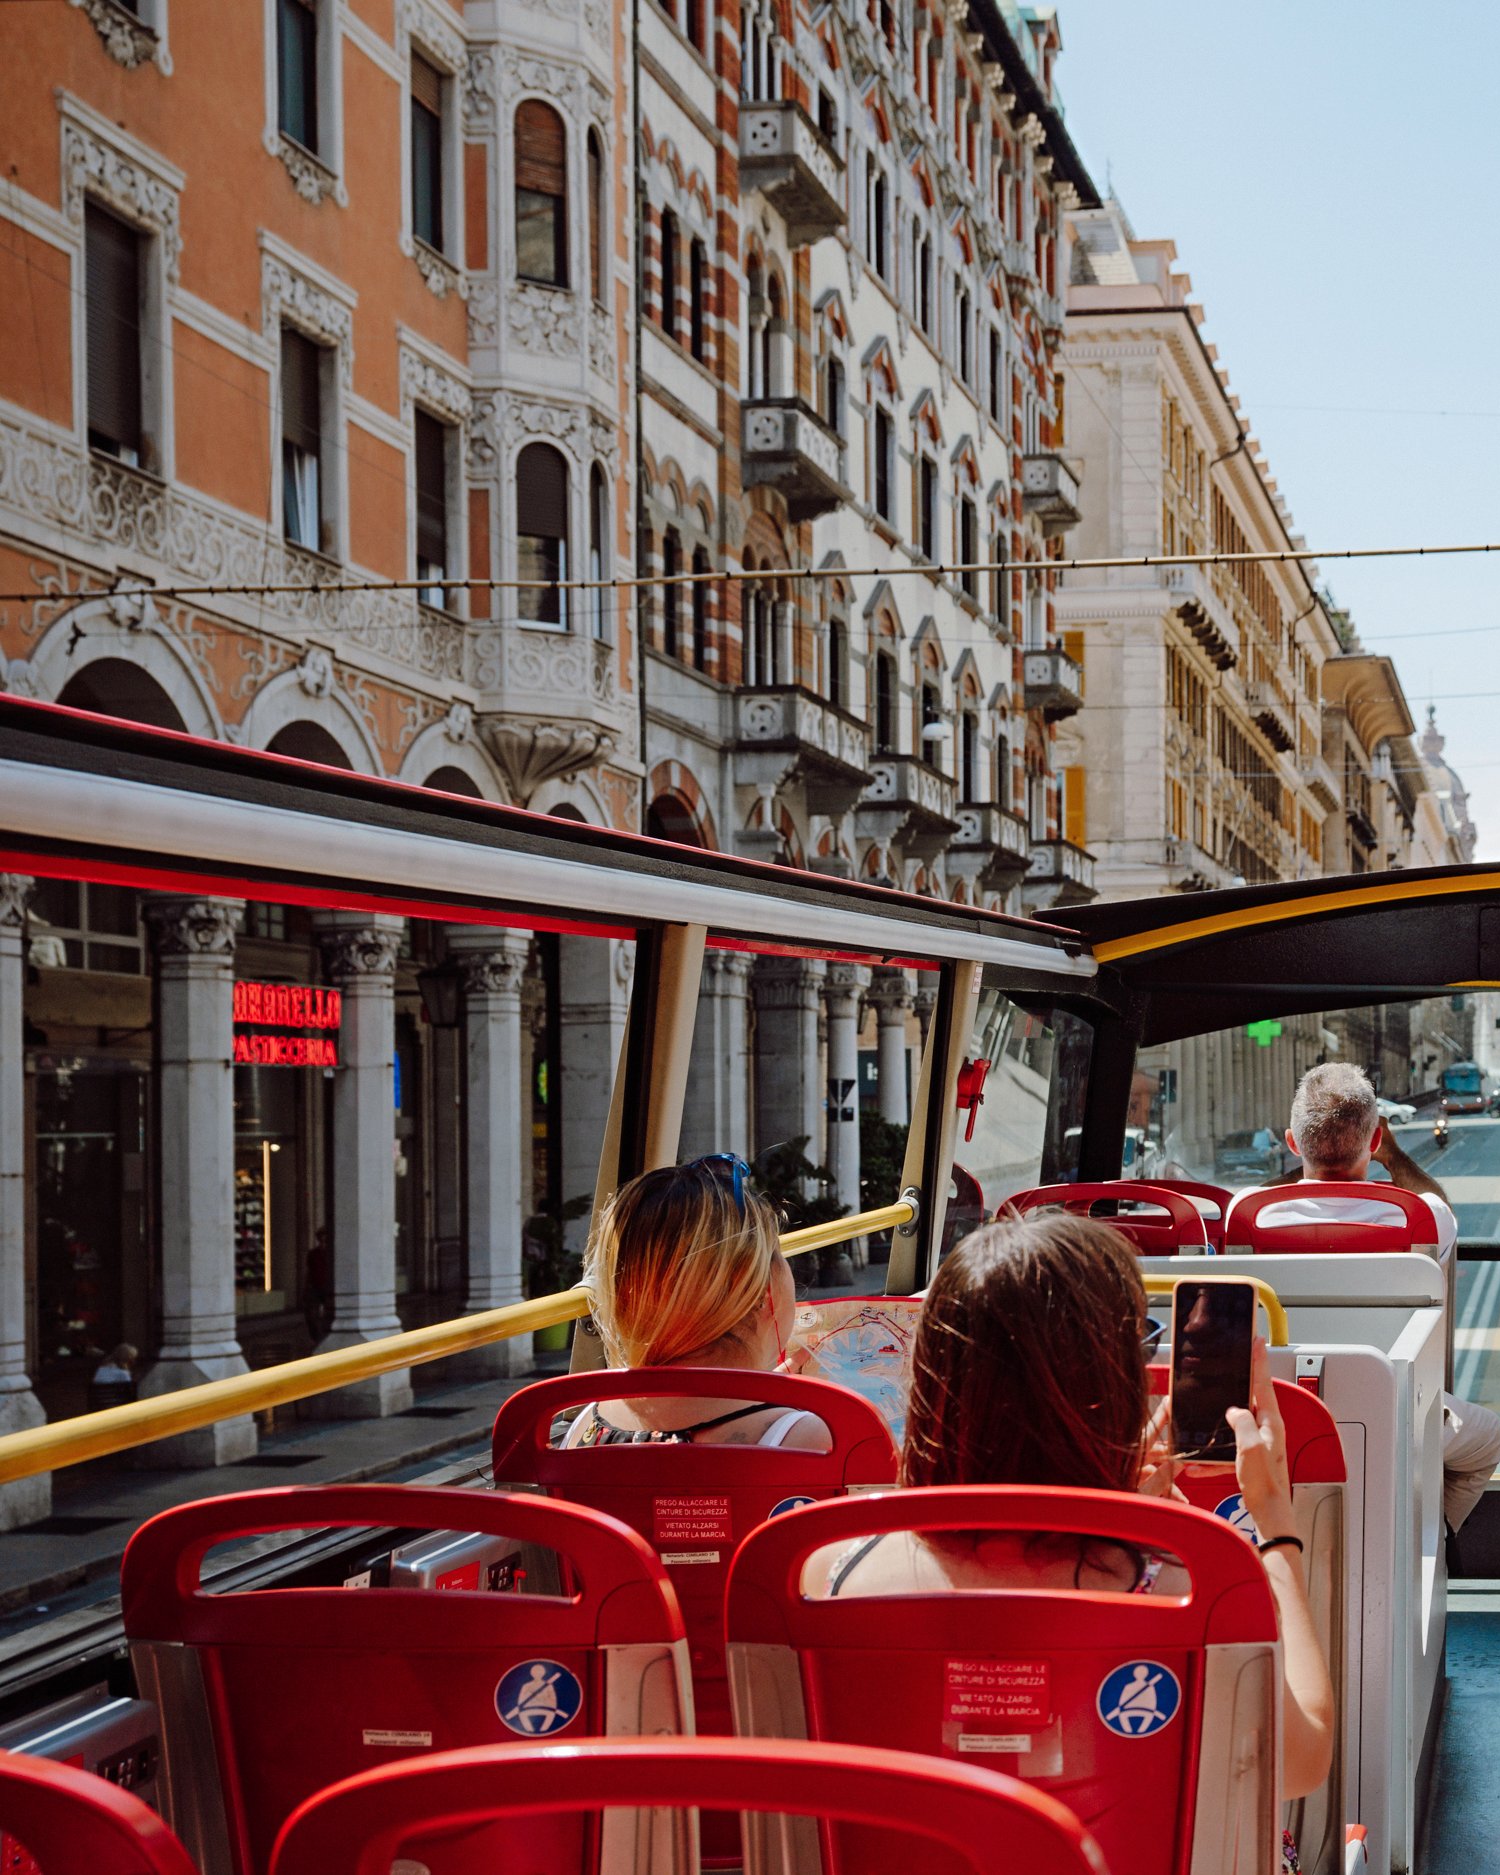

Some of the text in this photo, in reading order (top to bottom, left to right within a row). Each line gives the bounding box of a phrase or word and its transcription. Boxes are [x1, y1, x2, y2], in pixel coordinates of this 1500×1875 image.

[234, 981, 341, 1029] ANARELLO
[656, 1508, 683, 1516] CINTURE
[692, 1508, 728, 1516] SICUREZZA
[948, 1662, 1045, 1674] PREGO ALLACCIARE LE
[948, 1674, 983, 1685] CINTURE
[997, 1677, 1045, 1685] SICUREZZA
[959, 1693, 1032, 1704] VIETATO ALZARSI
[950, 1704, 1040, 1716] DURANTE LA MARCIA
